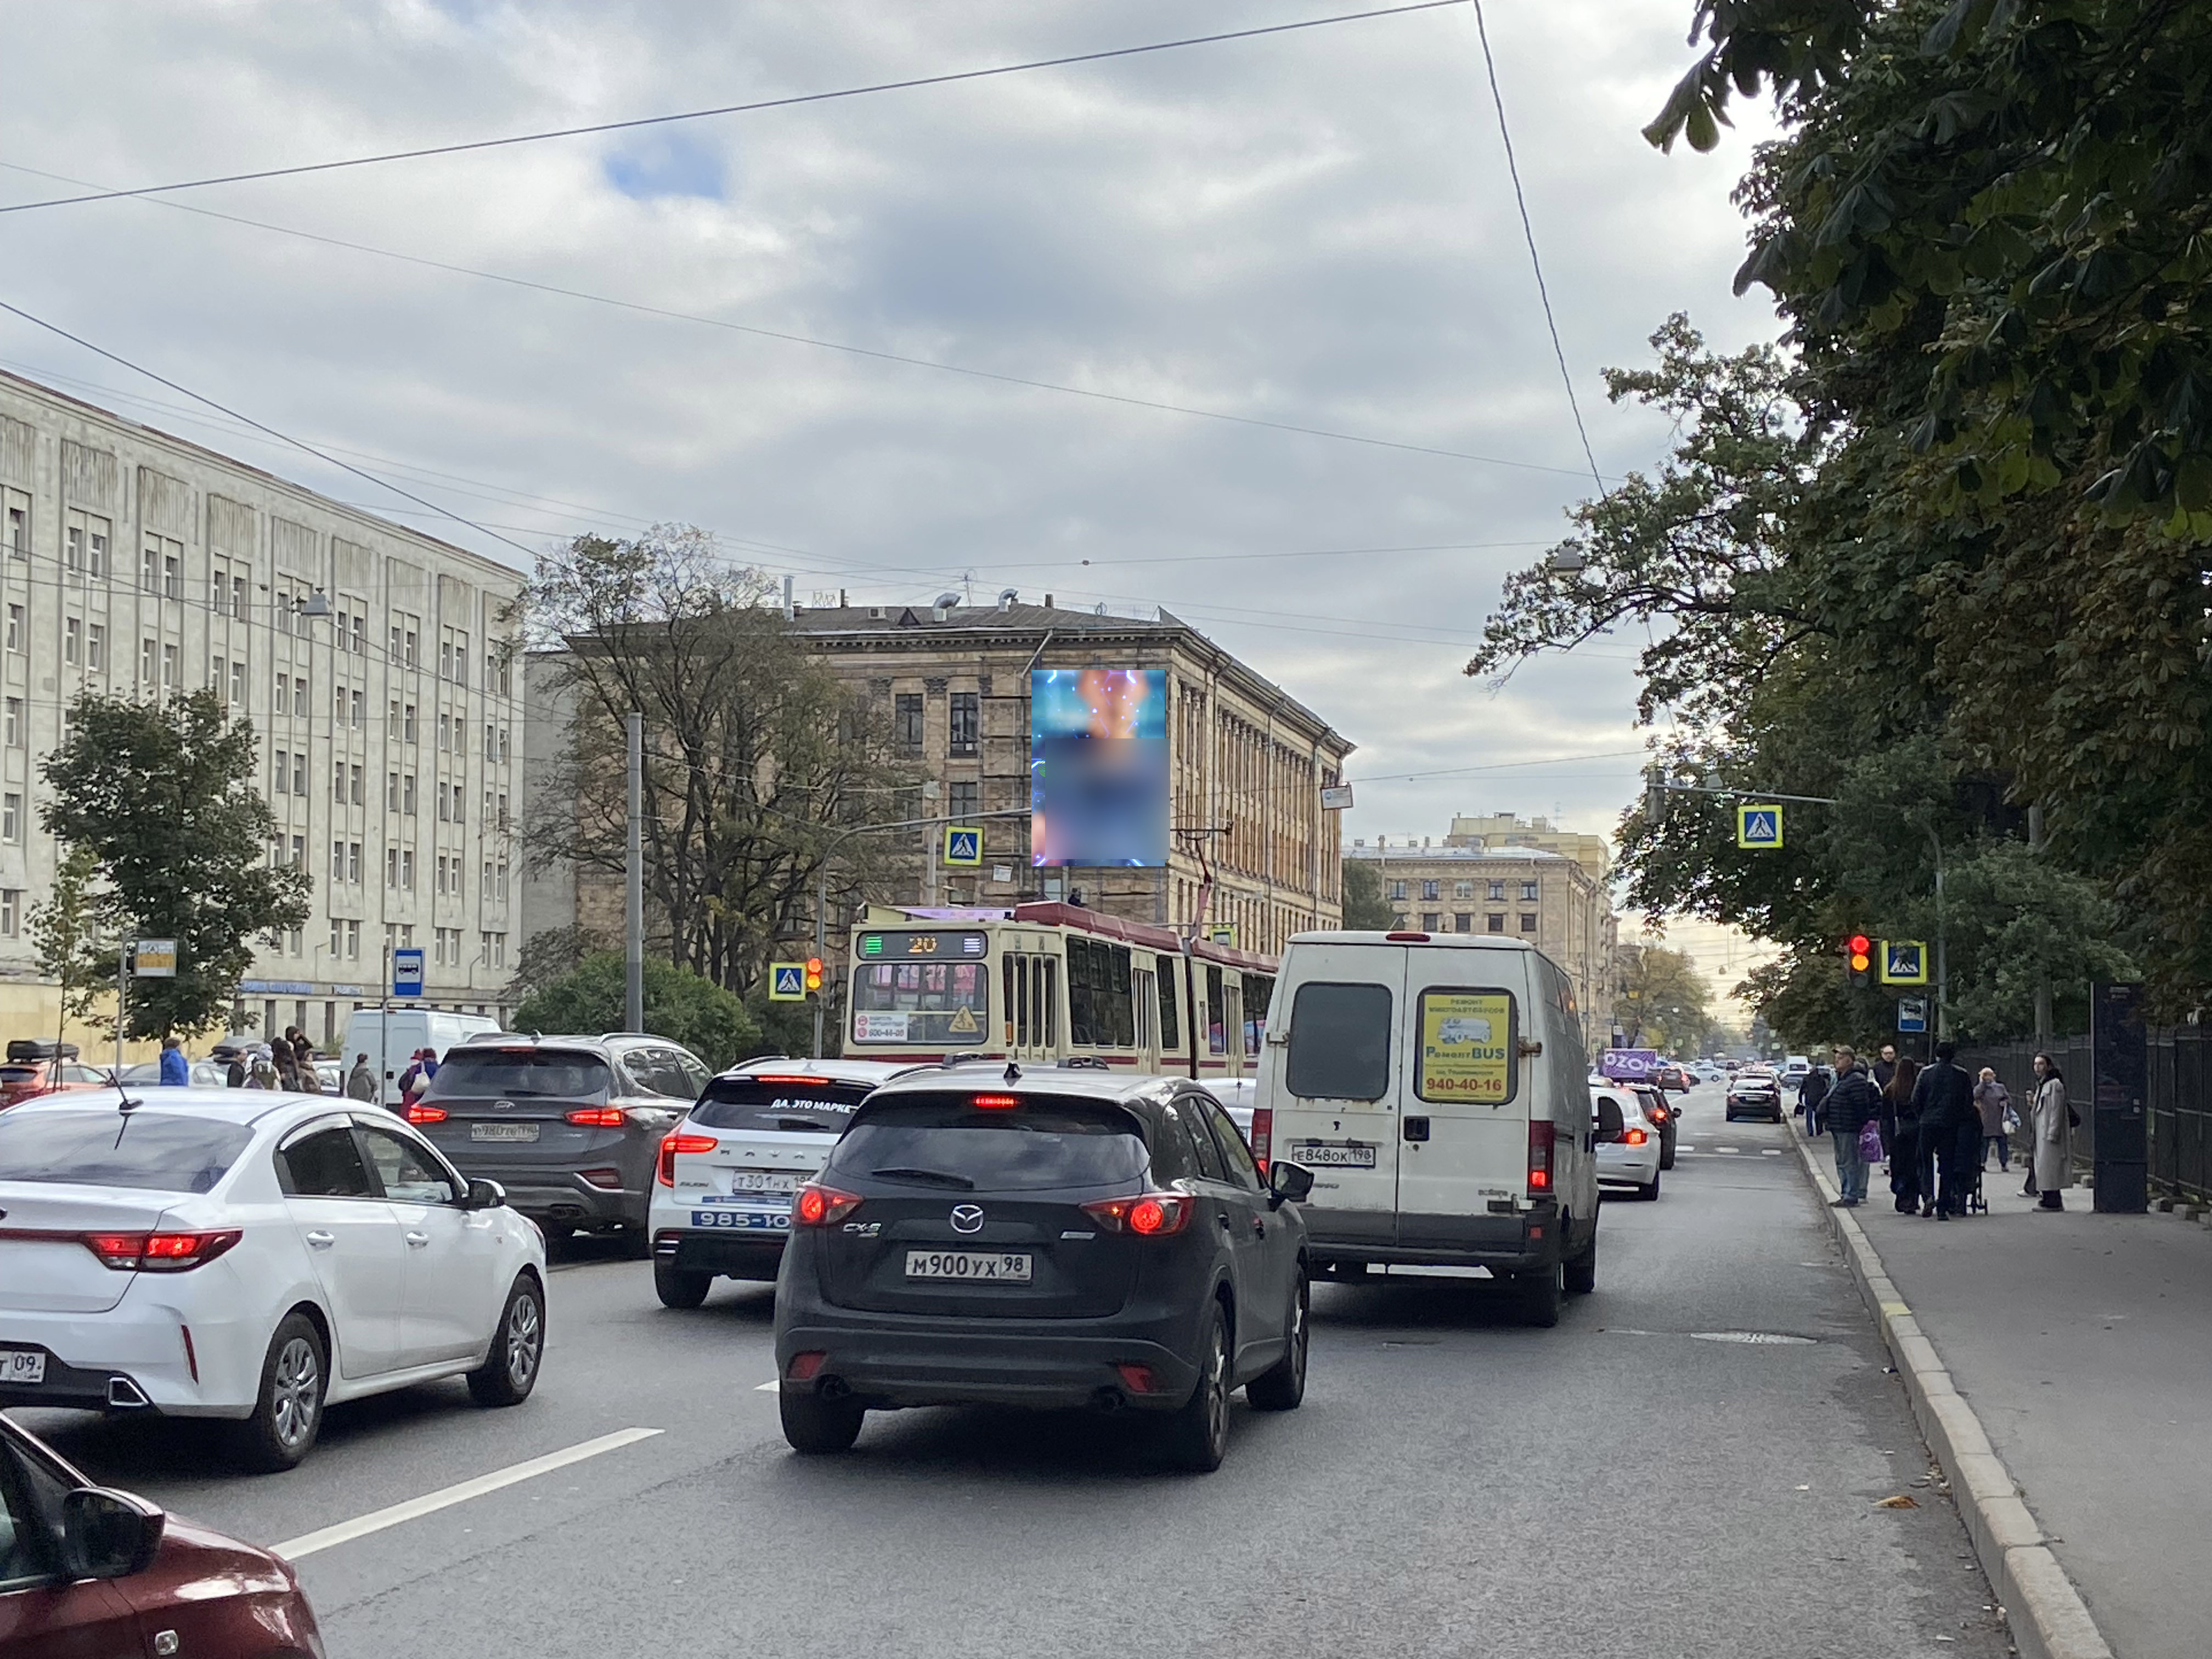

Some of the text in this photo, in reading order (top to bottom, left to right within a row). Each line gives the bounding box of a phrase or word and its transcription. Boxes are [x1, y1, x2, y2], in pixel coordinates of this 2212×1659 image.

[908, 937, 937, 953] 20
[1427, 1077, 1502, 1091] 940-40-16
[792, 1099, 813, 1109] ЭТО
[737, 1175, 789, 1189] Т301НХ
[912, 1255, 1023, 1277] М900УХ 98
[15, 1355, 36, 1372] 09
